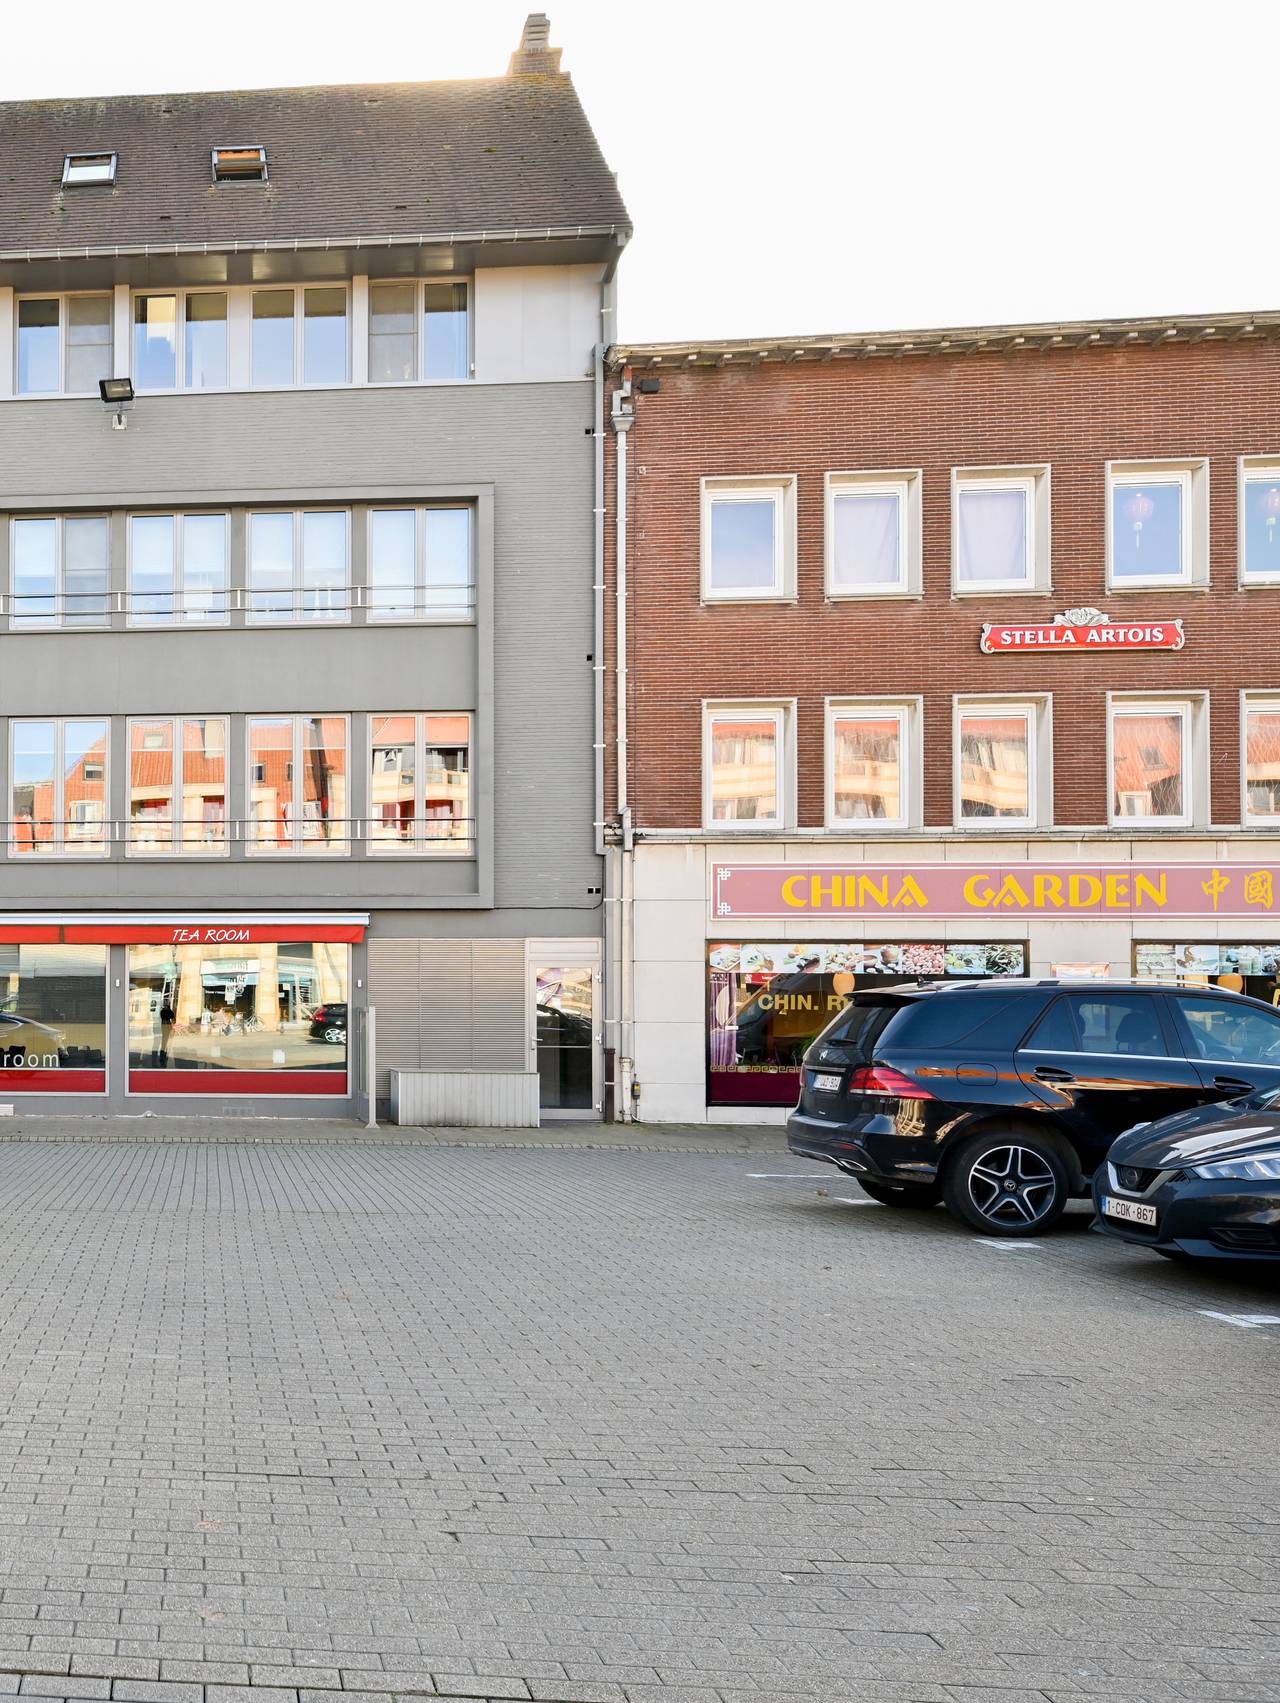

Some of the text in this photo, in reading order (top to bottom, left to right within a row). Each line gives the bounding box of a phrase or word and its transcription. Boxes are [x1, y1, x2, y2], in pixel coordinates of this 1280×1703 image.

[1000, 627, 1164, 645] STELLA ARTOIS
[781, 872, 1168, 908] CHINA GARDEN
[172, 928, 251, 942] TEA ROOM
[758, 994, 819, 1011] CHIN.
